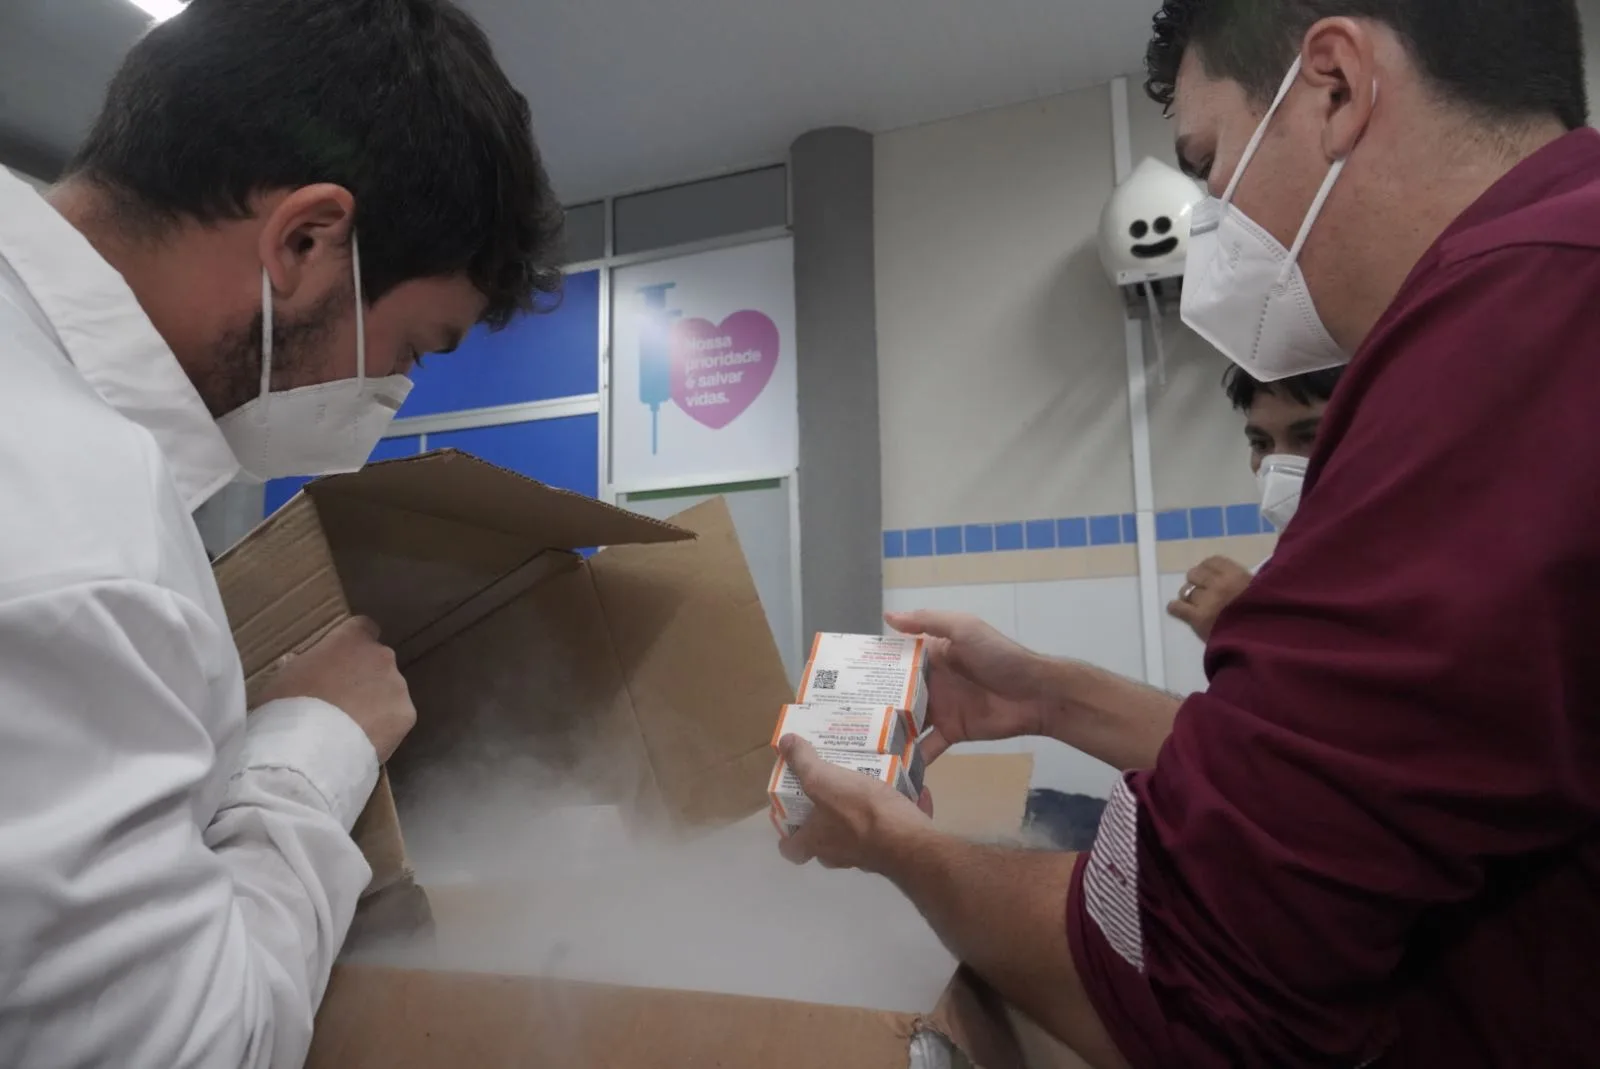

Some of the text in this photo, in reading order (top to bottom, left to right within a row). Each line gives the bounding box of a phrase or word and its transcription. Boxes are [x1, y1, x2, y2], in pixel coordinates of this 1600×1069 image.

[685, 348, 762, 376] prioridade
[698, 371, 744, 388] salvar
[685, 391, 730, 408] vidas.
